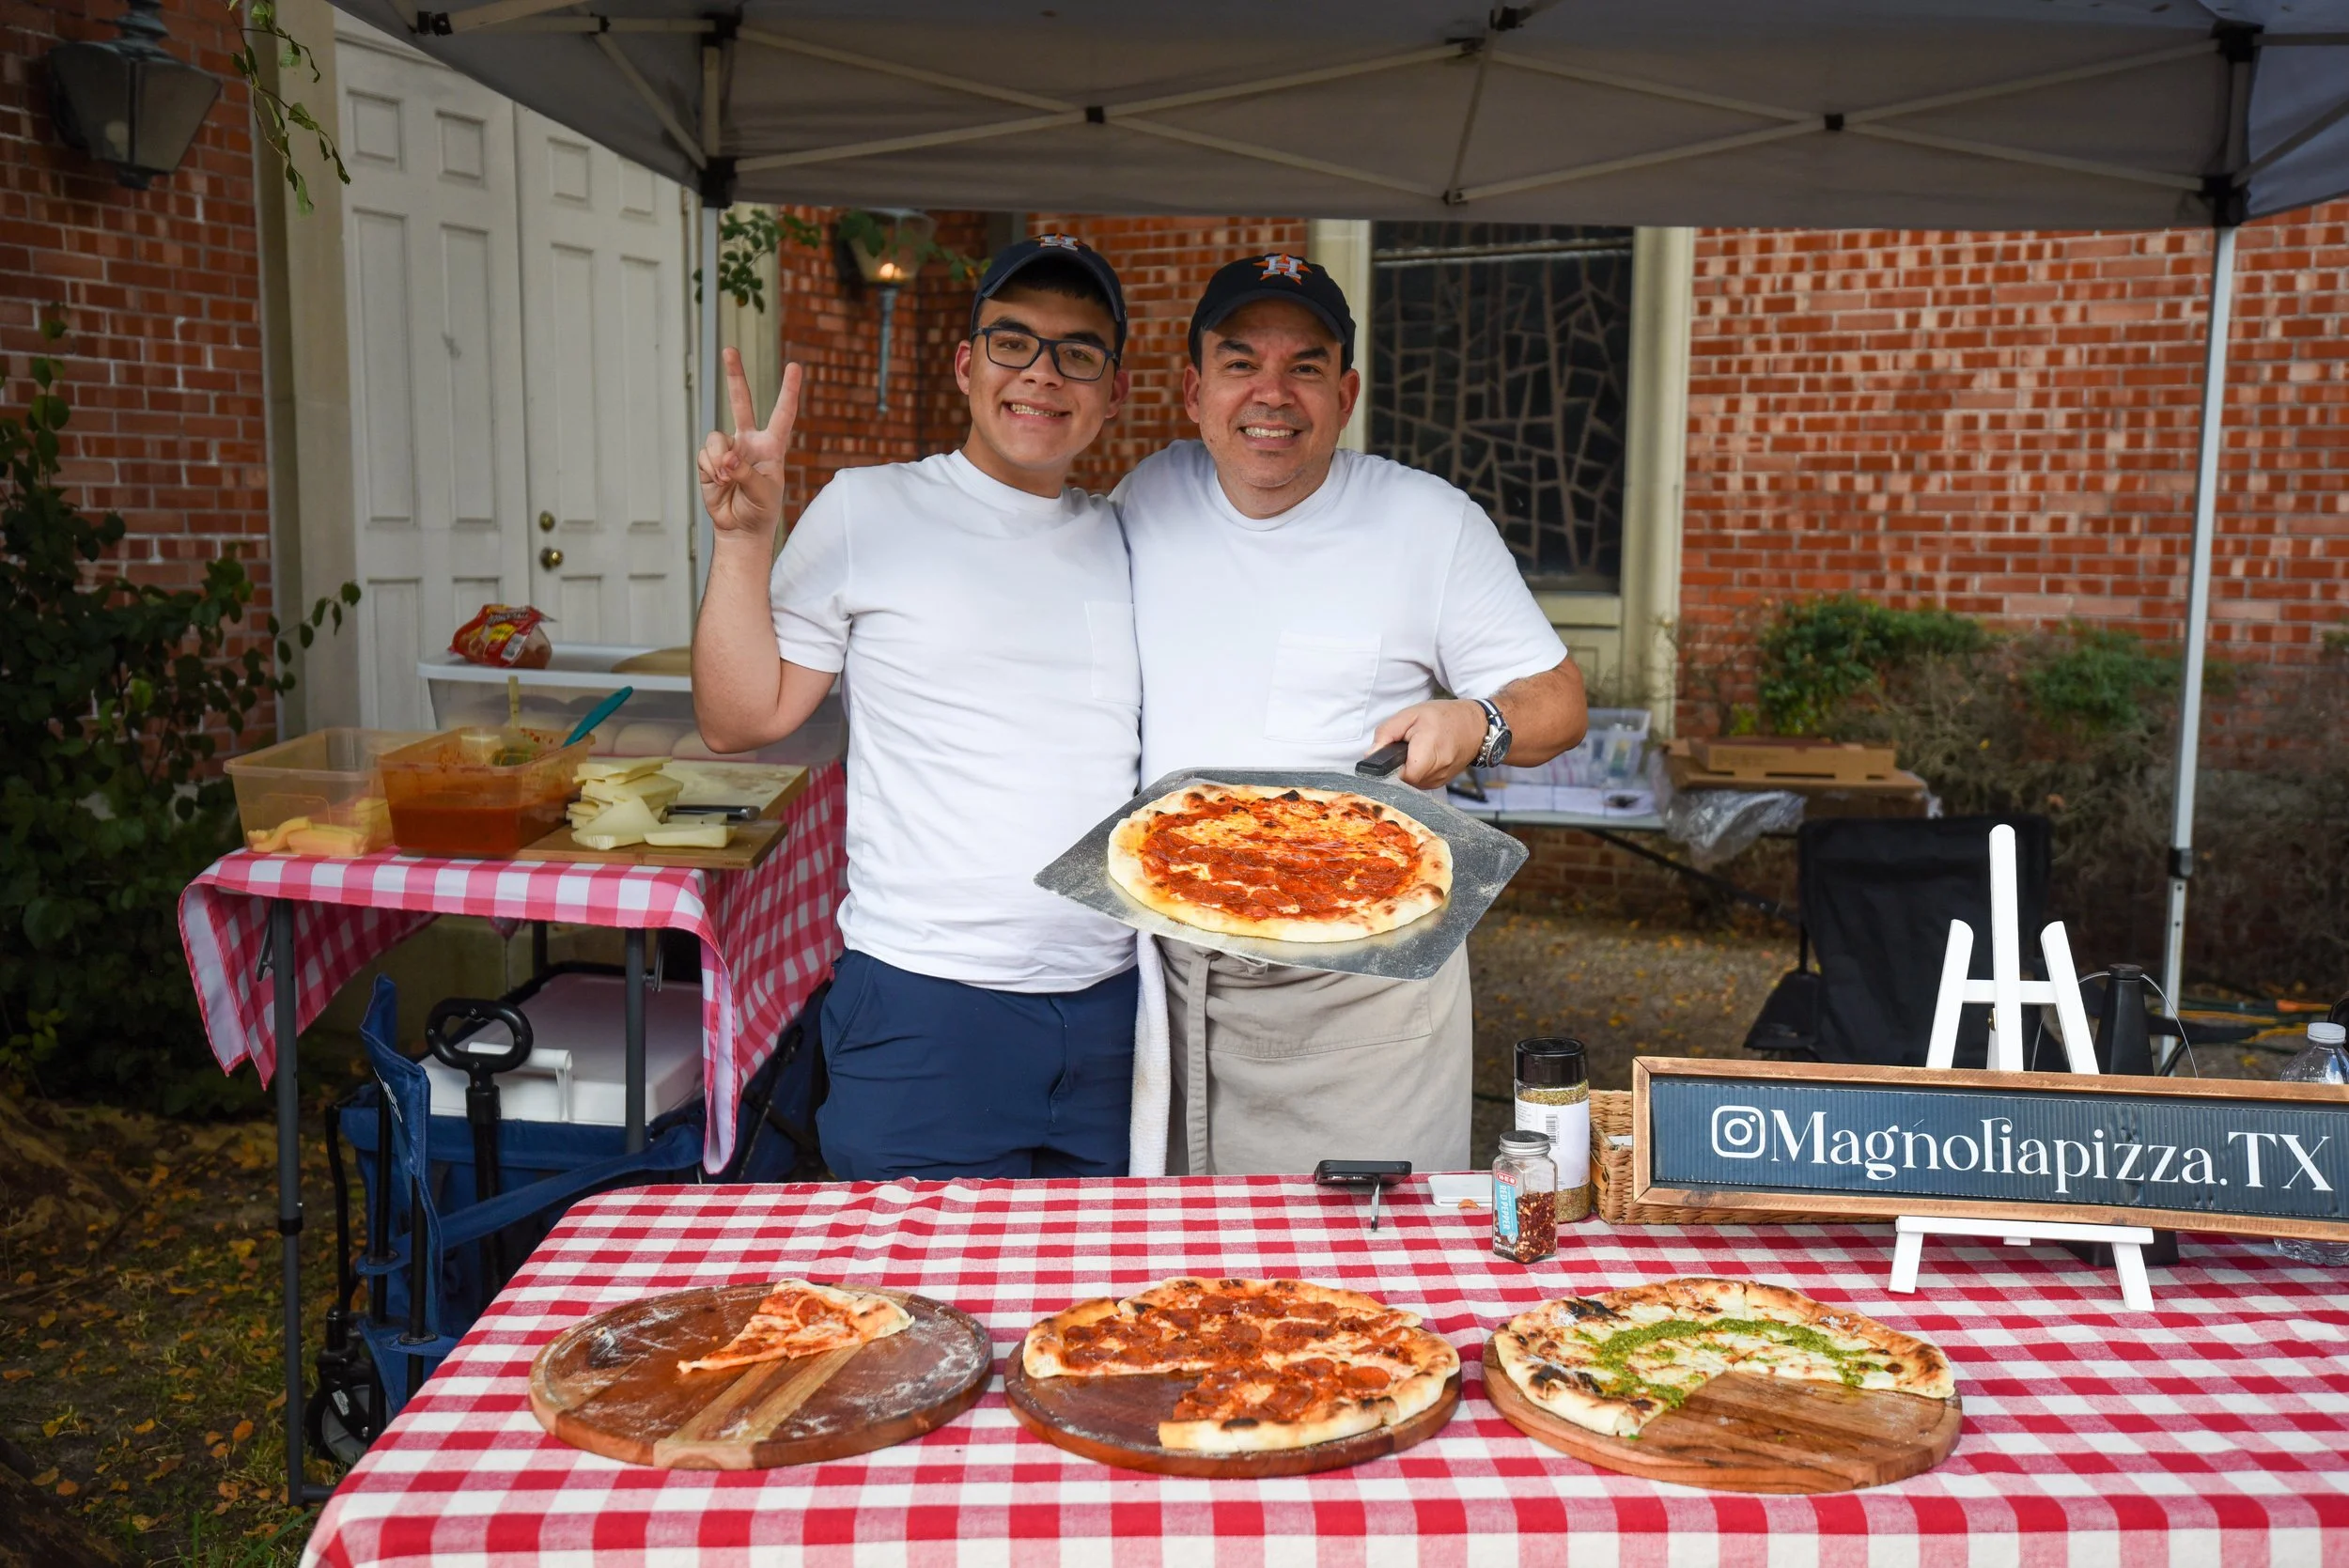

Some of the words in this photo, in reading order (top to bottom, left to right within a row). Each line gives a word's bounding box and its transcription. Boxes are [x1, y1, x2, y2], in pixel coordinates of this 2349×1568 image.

[1262, 256, 1302, 279] H
[1770, 1108, 2334, 1194] Magnoliapizza.TX
[1499, 1185, 1508, 1201] RED
[1500, 1202, 1511, 1230] PEPPER
